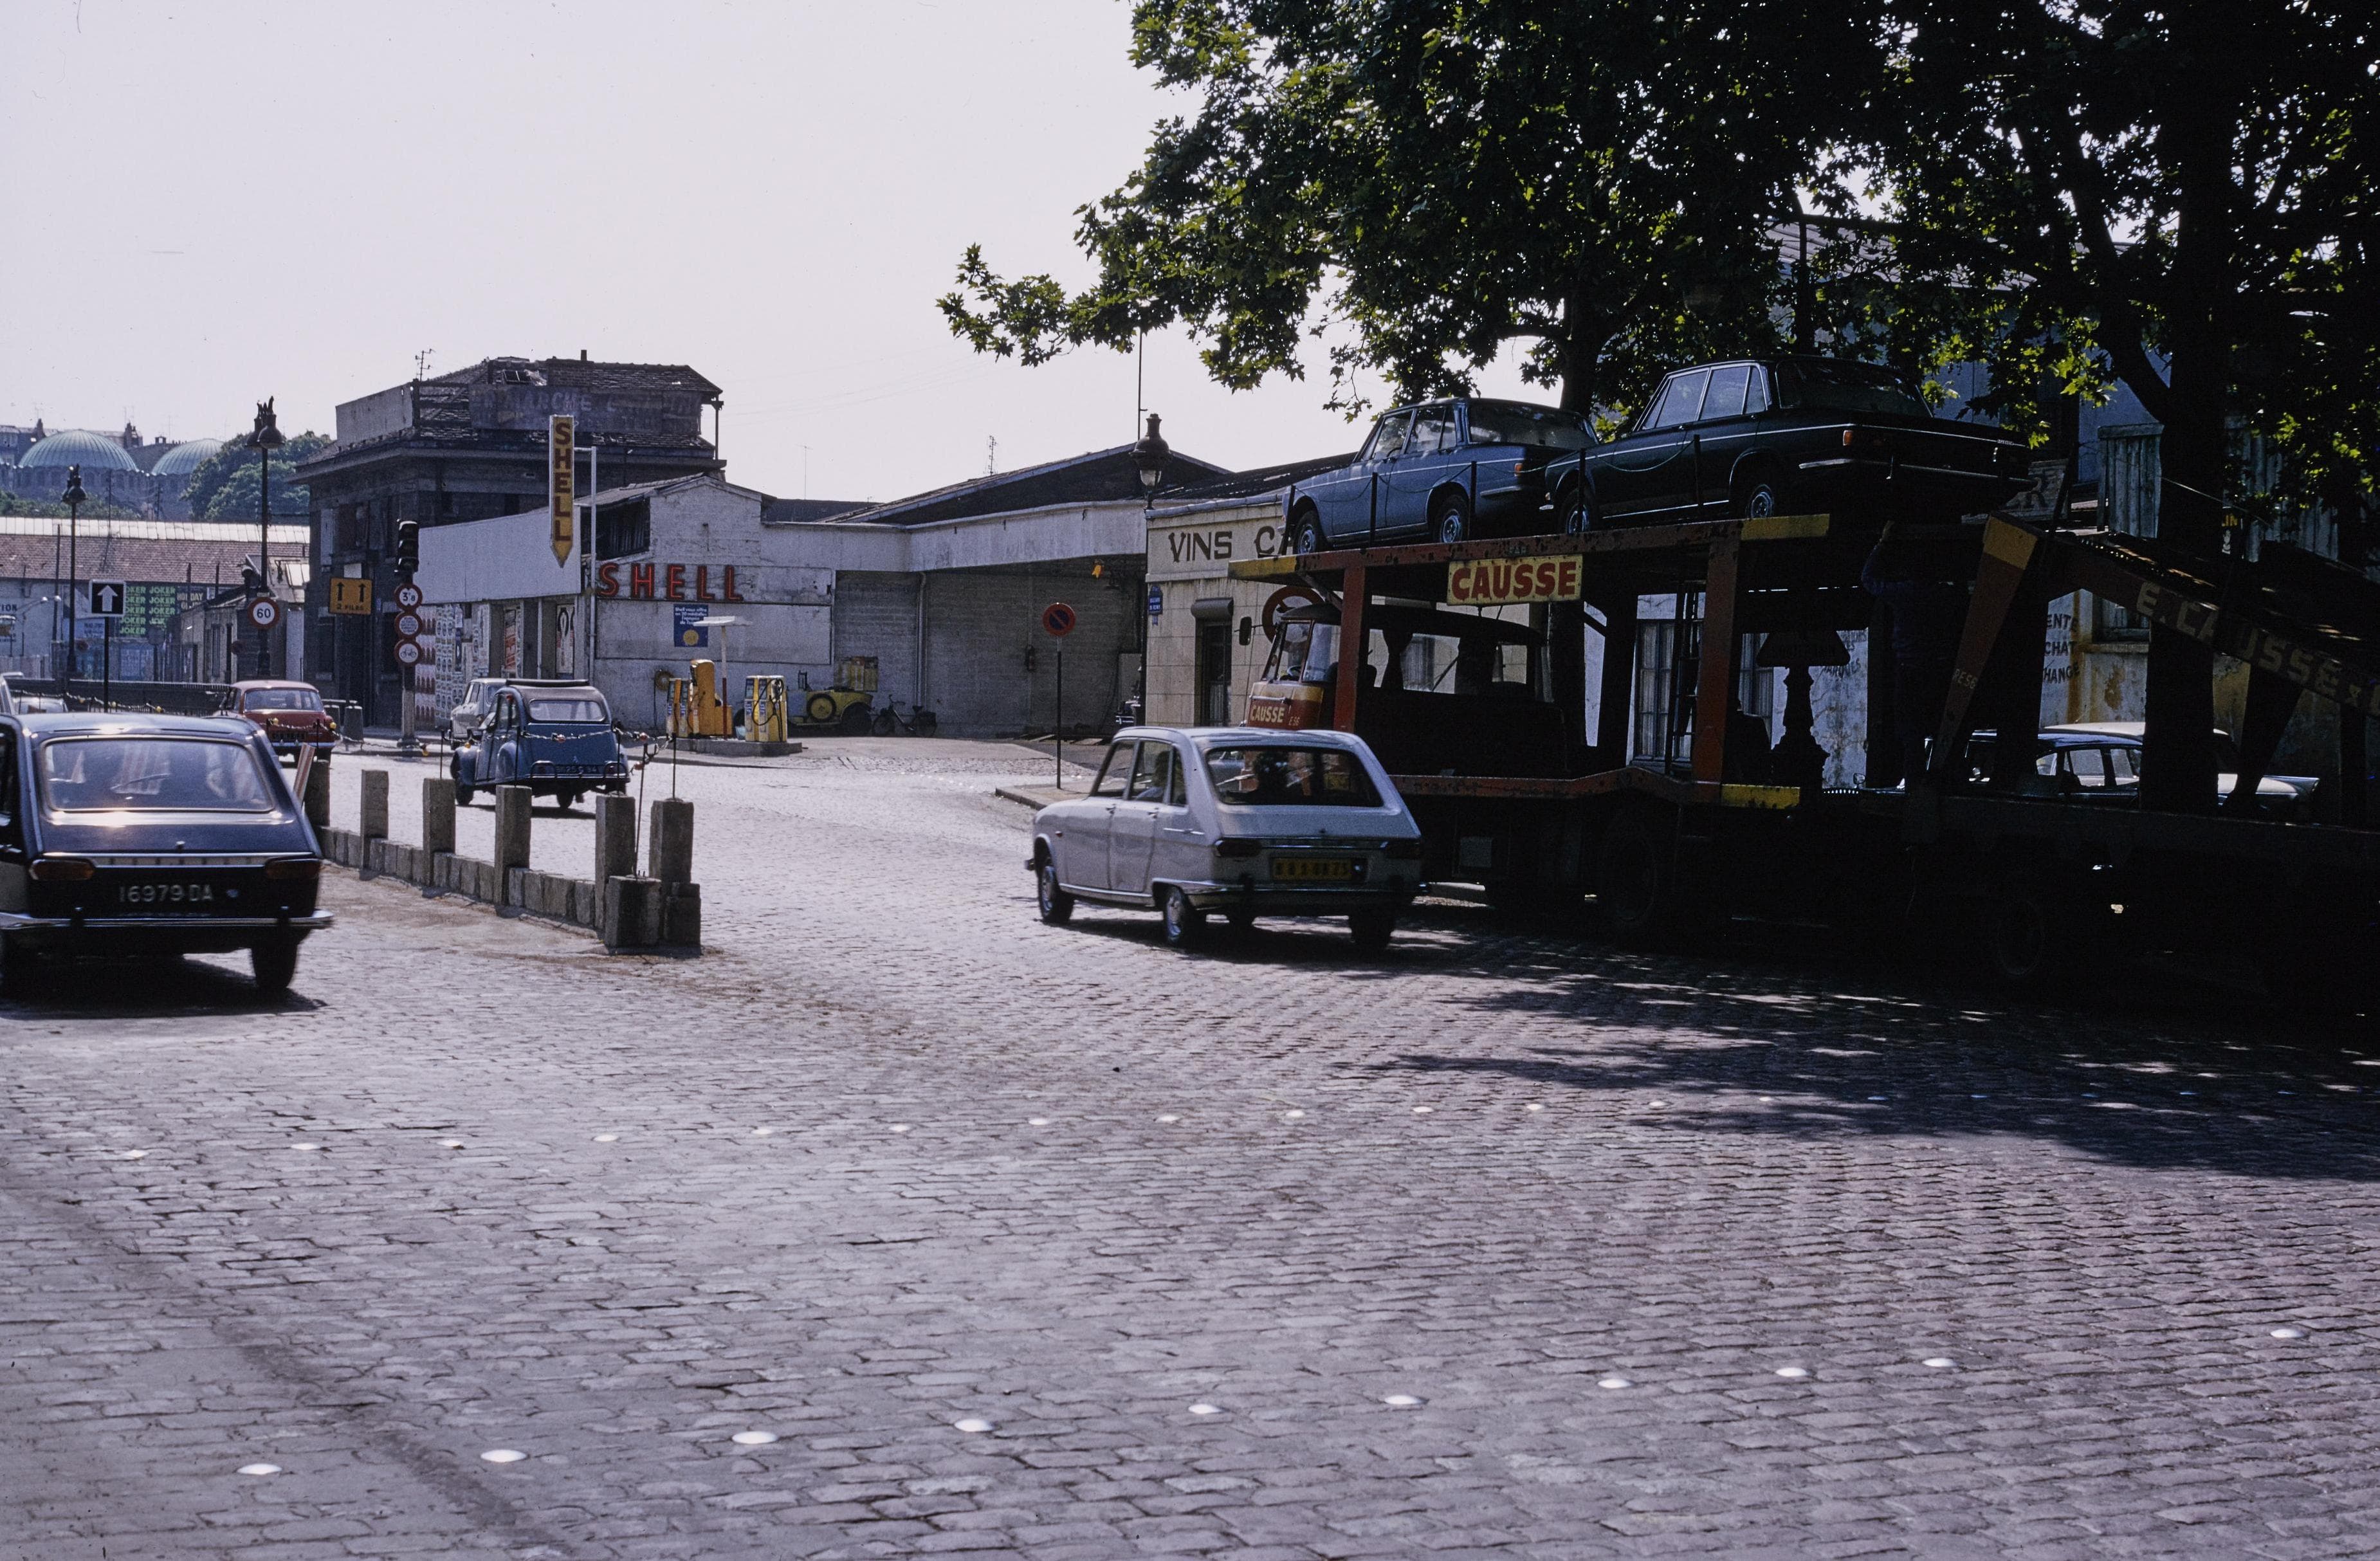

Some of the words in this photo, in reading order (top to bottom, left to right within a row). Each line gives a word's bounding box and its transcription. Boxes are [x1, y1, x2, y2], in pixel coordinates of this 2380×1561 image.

[554, 422, 572, 542] SHELL
[1168, 531, 1232, 563] VINS
[149, 586, 175, 594] JOKER
[598, 561, 744, 603] SHELL
[1452, 561, 1576, 601] CAUSSE
[149, 607, 175, 616] JOKER
[257, 608, 271, 618] 60
[1250, 704, 1285, 723] CAUSSE
